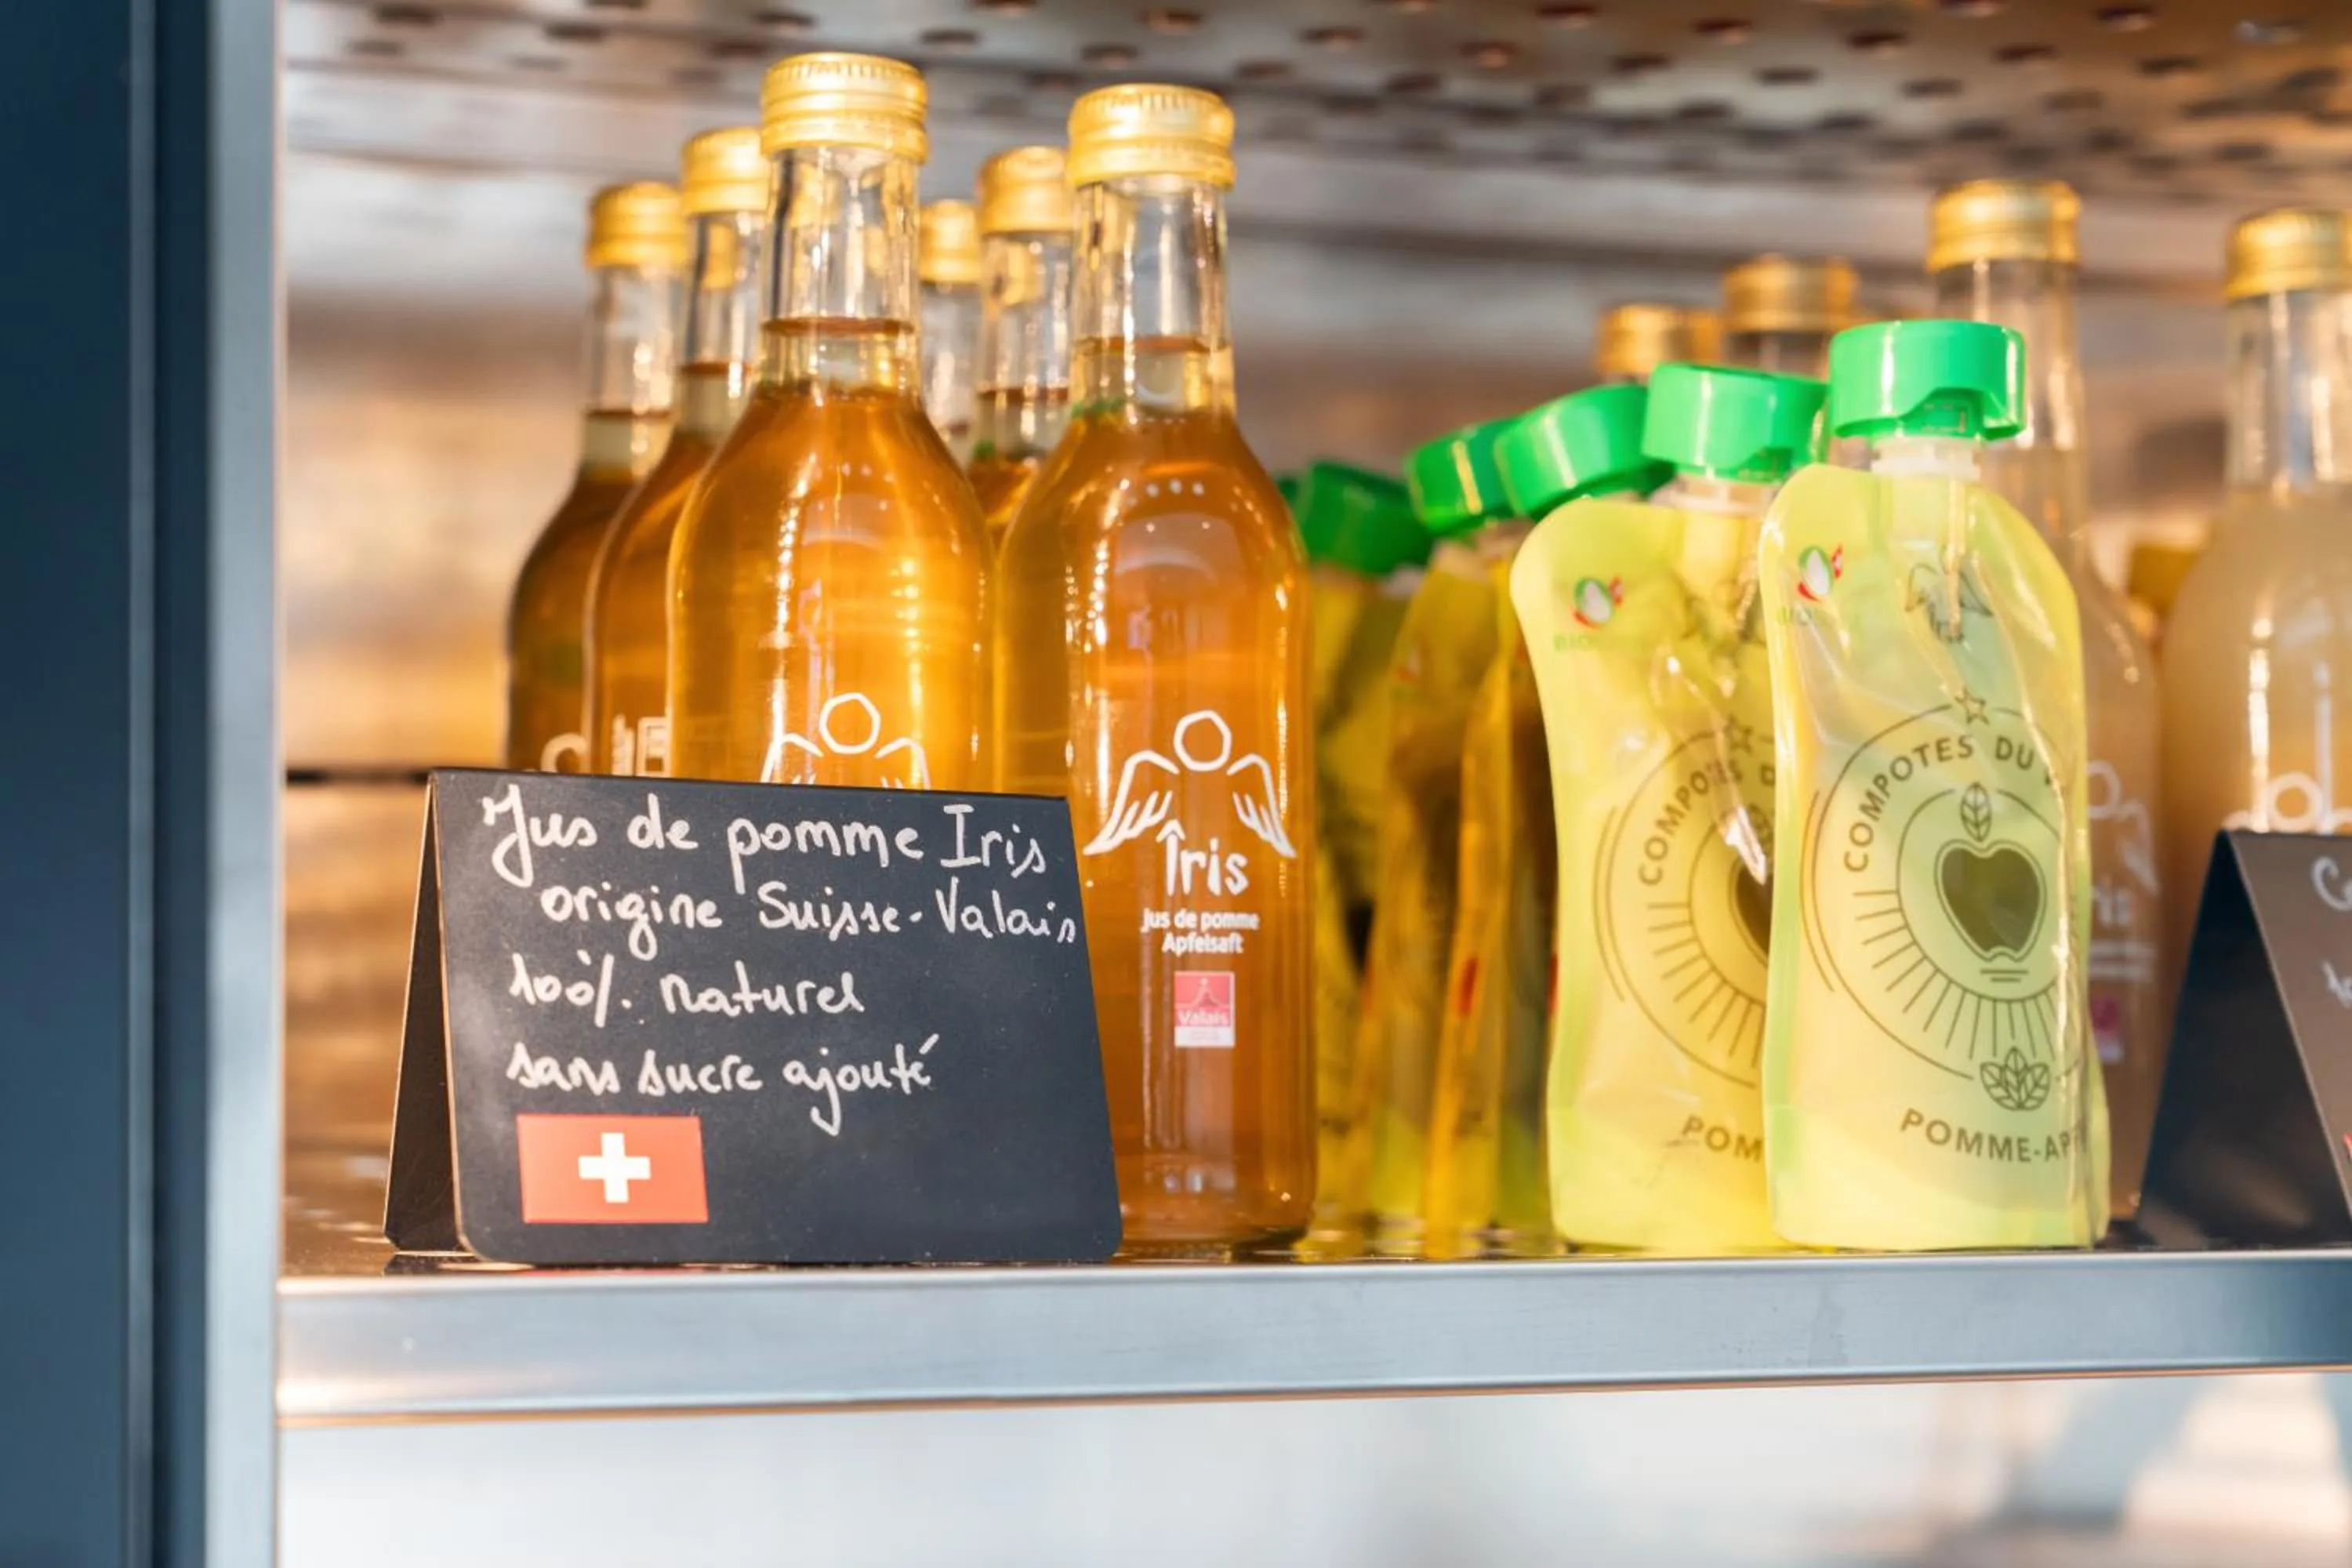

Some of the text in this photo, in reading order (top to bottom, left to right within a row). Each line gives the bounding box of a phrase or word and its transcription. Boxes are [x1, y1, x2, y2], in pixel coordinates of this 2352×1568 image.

[480, 782, 1047, 895] Jus de pomme Iris
[1843, 735, 2034, 873] COMPOTES DU
[540, 880, 723, 961] origine
[1161, 931, 1244, 958] Apfelsaft
[1174, 907, 1198, 929] de
[1200, 912, 1260, 933] pomme
[506, 1033, 939, 1137] sans sucre ajouté
